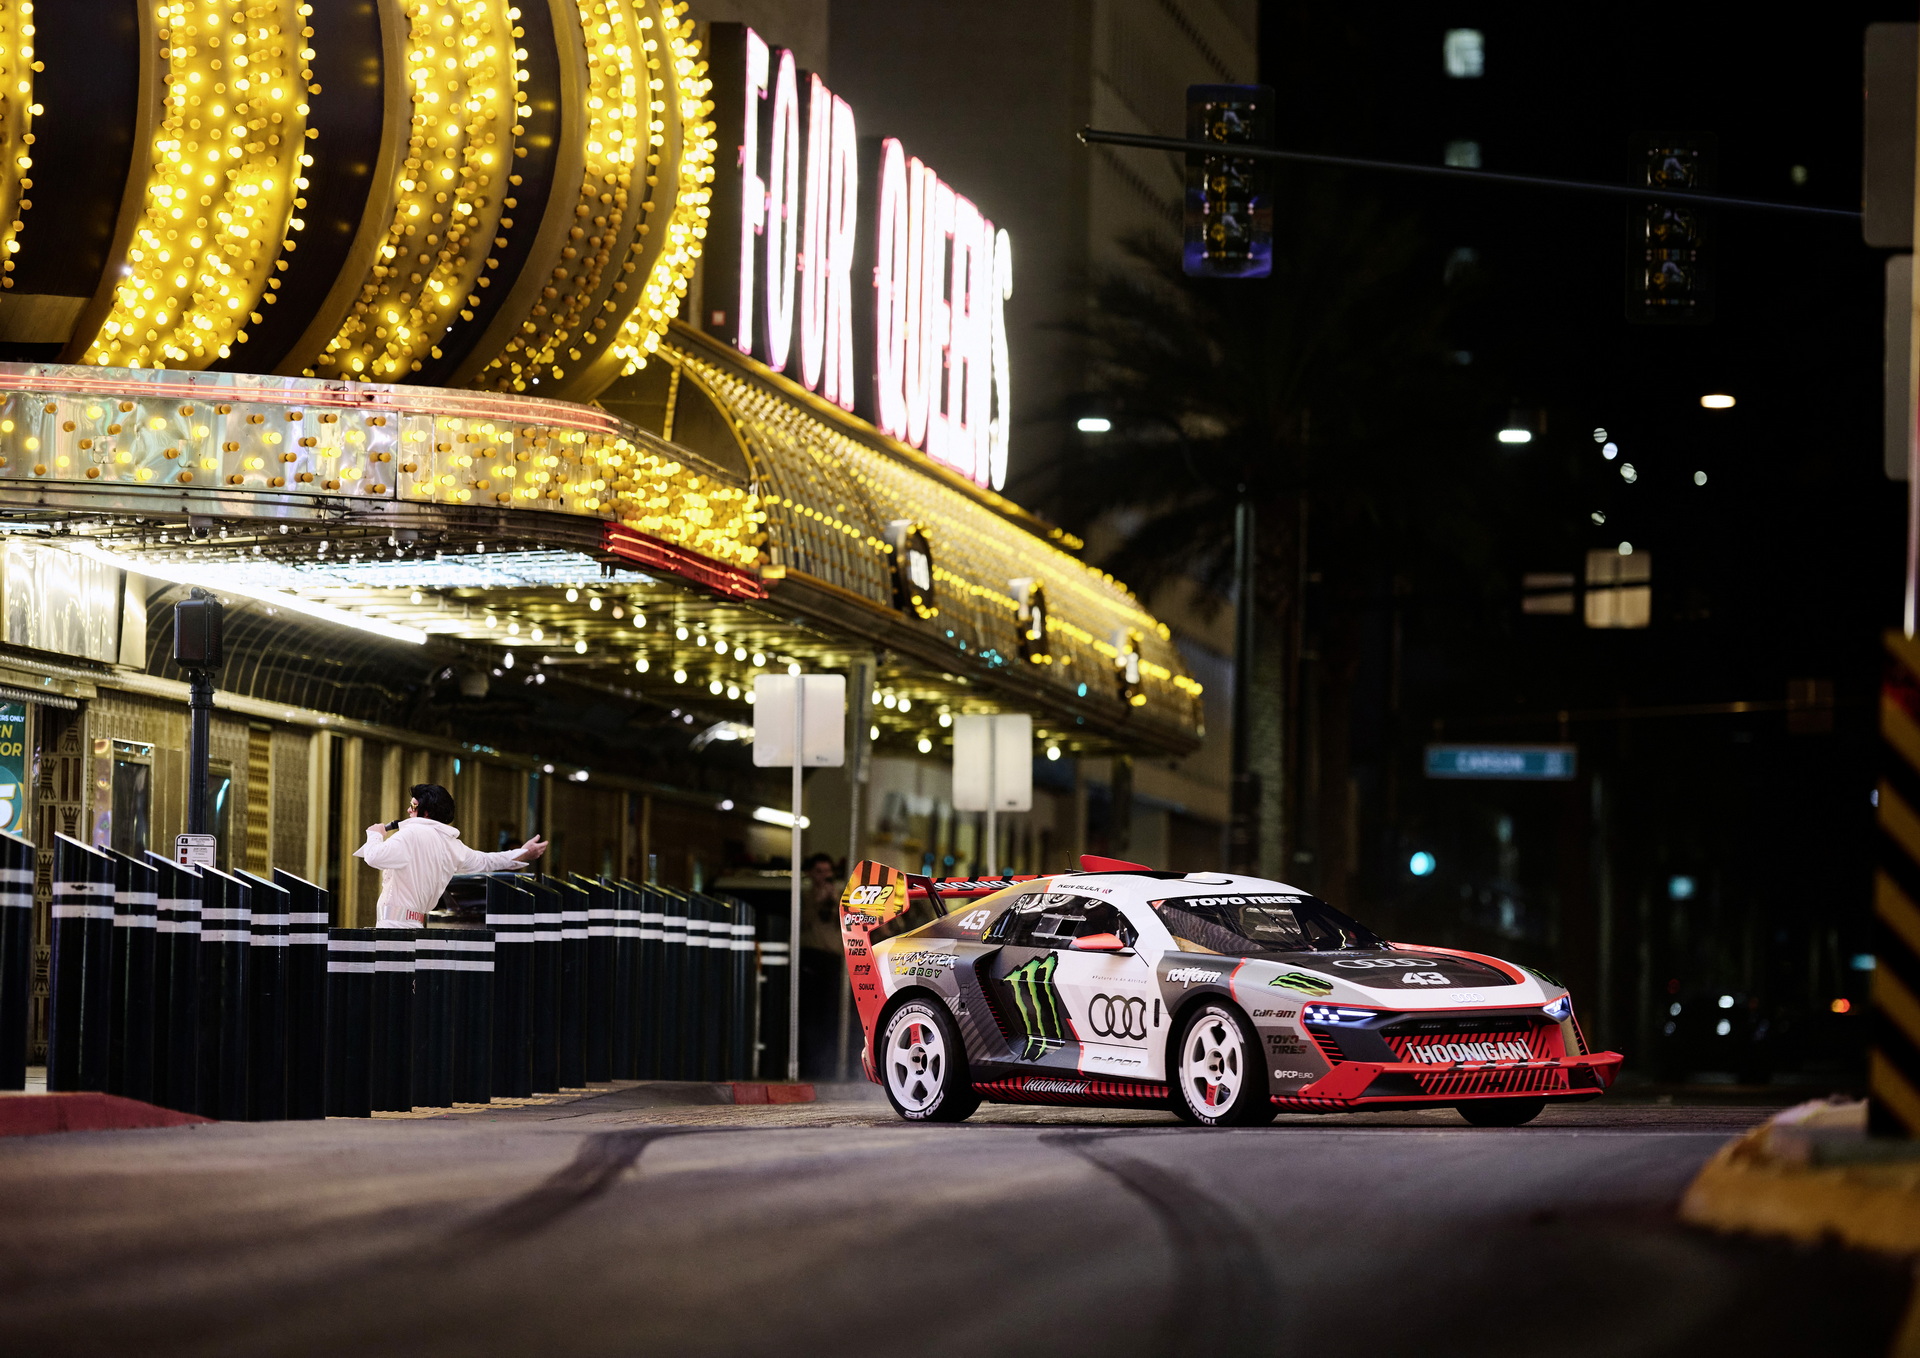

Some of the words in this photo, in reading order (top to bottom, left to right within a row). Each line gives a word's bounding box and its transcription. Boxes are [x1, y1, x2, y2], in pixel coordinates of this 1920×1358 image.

[738, 27, 858, 411] FOUR
[876, 137, 1013, 492] QUEENS
[0, 742, 23, 757] OR
[1184, 896, 1243, 907] TOYO
[1244, 895, 1303, 905] TIRES
[958, 910, 991, 931] 43
[847, 938, 864, 948] TOYO
[848, 948, 867, 956] TIRES
[893, 966, 943, 979] ENERGY
[1401, 971, 1451, 985] 43
[886, 1008, 908, 1038] TOYO
[907, 1004, 935, 1018] TIRES
[1266, 1035, 1299, 1045] TOYO
[1271, 1045, 1308, 1055] TIRES
[1283, 1070, 1299, 1079] FCP
